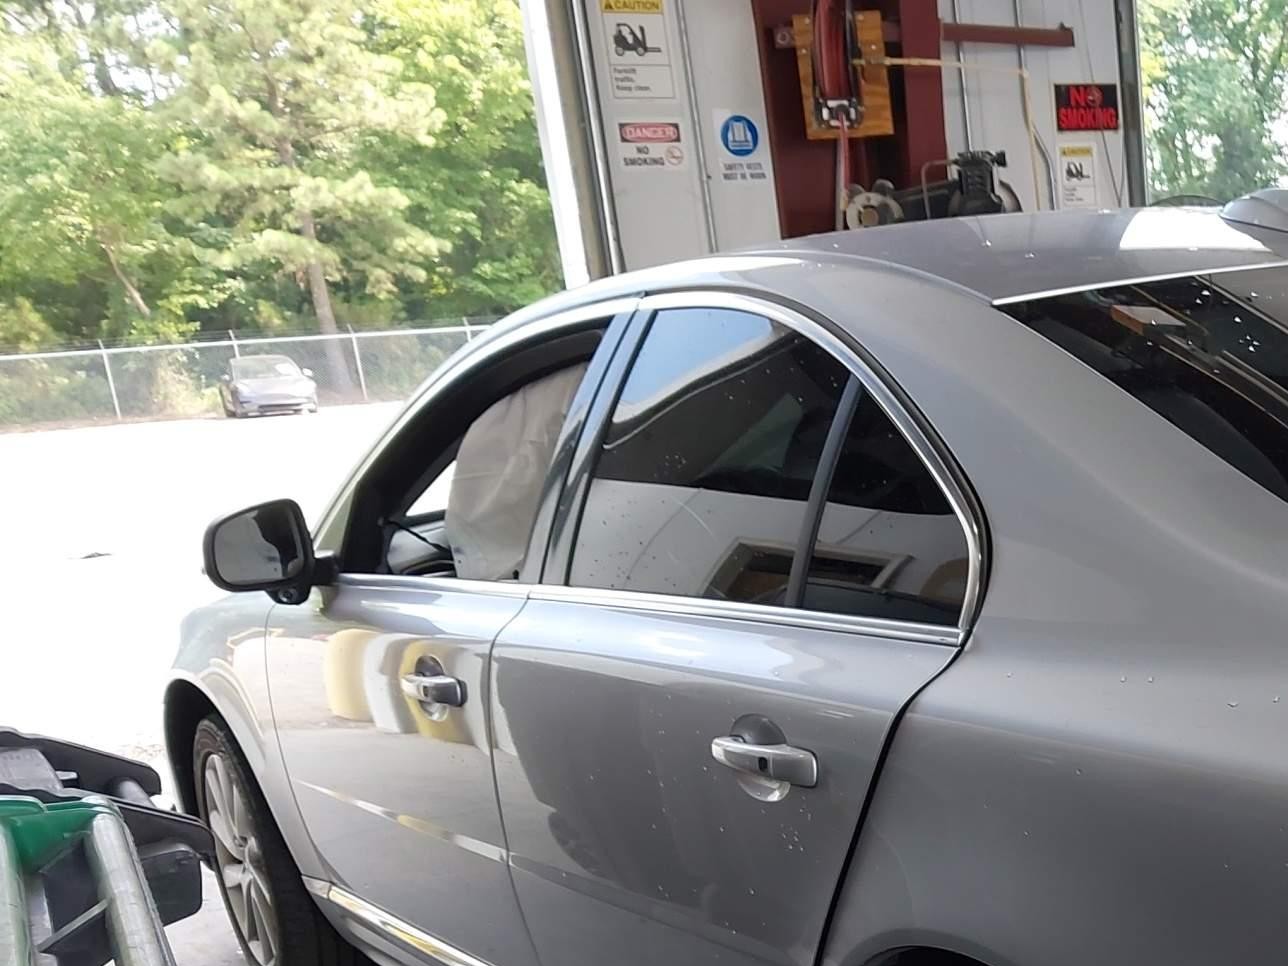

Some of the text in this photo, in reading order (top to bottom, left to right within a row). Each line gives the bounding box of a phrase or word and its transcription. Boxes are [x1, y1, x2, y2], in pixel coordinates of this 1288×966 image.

[614, 0, 660, 10] CAUTION
[1068, 85, 1103, 107] NO
[1059, 106, 1117, 129] SMOKING
[625, 125, 675, 139] DANGER
[635, 145, 650, 155] NO
[623, 156, 665, 167] SMOKING
